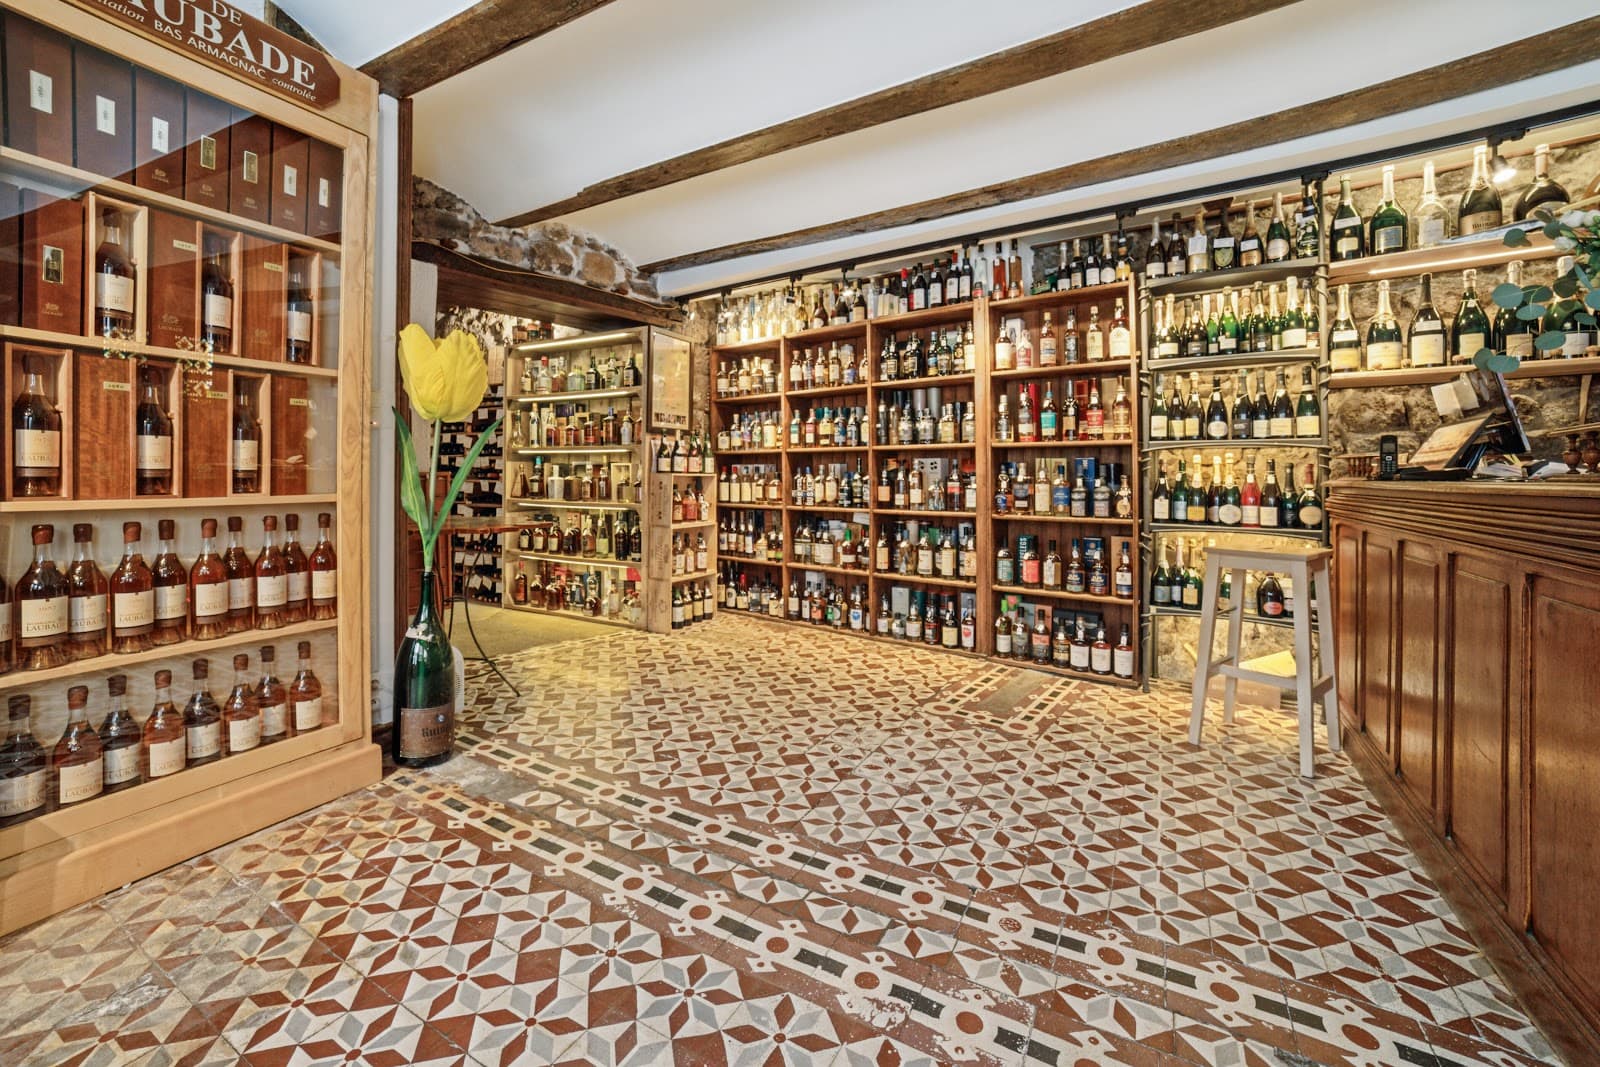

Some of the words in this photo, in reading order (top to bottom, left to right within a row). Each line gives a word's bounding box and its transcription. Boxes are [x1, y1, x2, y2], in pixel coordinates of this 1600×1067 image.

[211, 0, 243, 27] DE
[154, 19, 183, 41] BAS
[187, 37, 266, 80] ARMAGNAC
[271, 78, 318, 102] controlée
